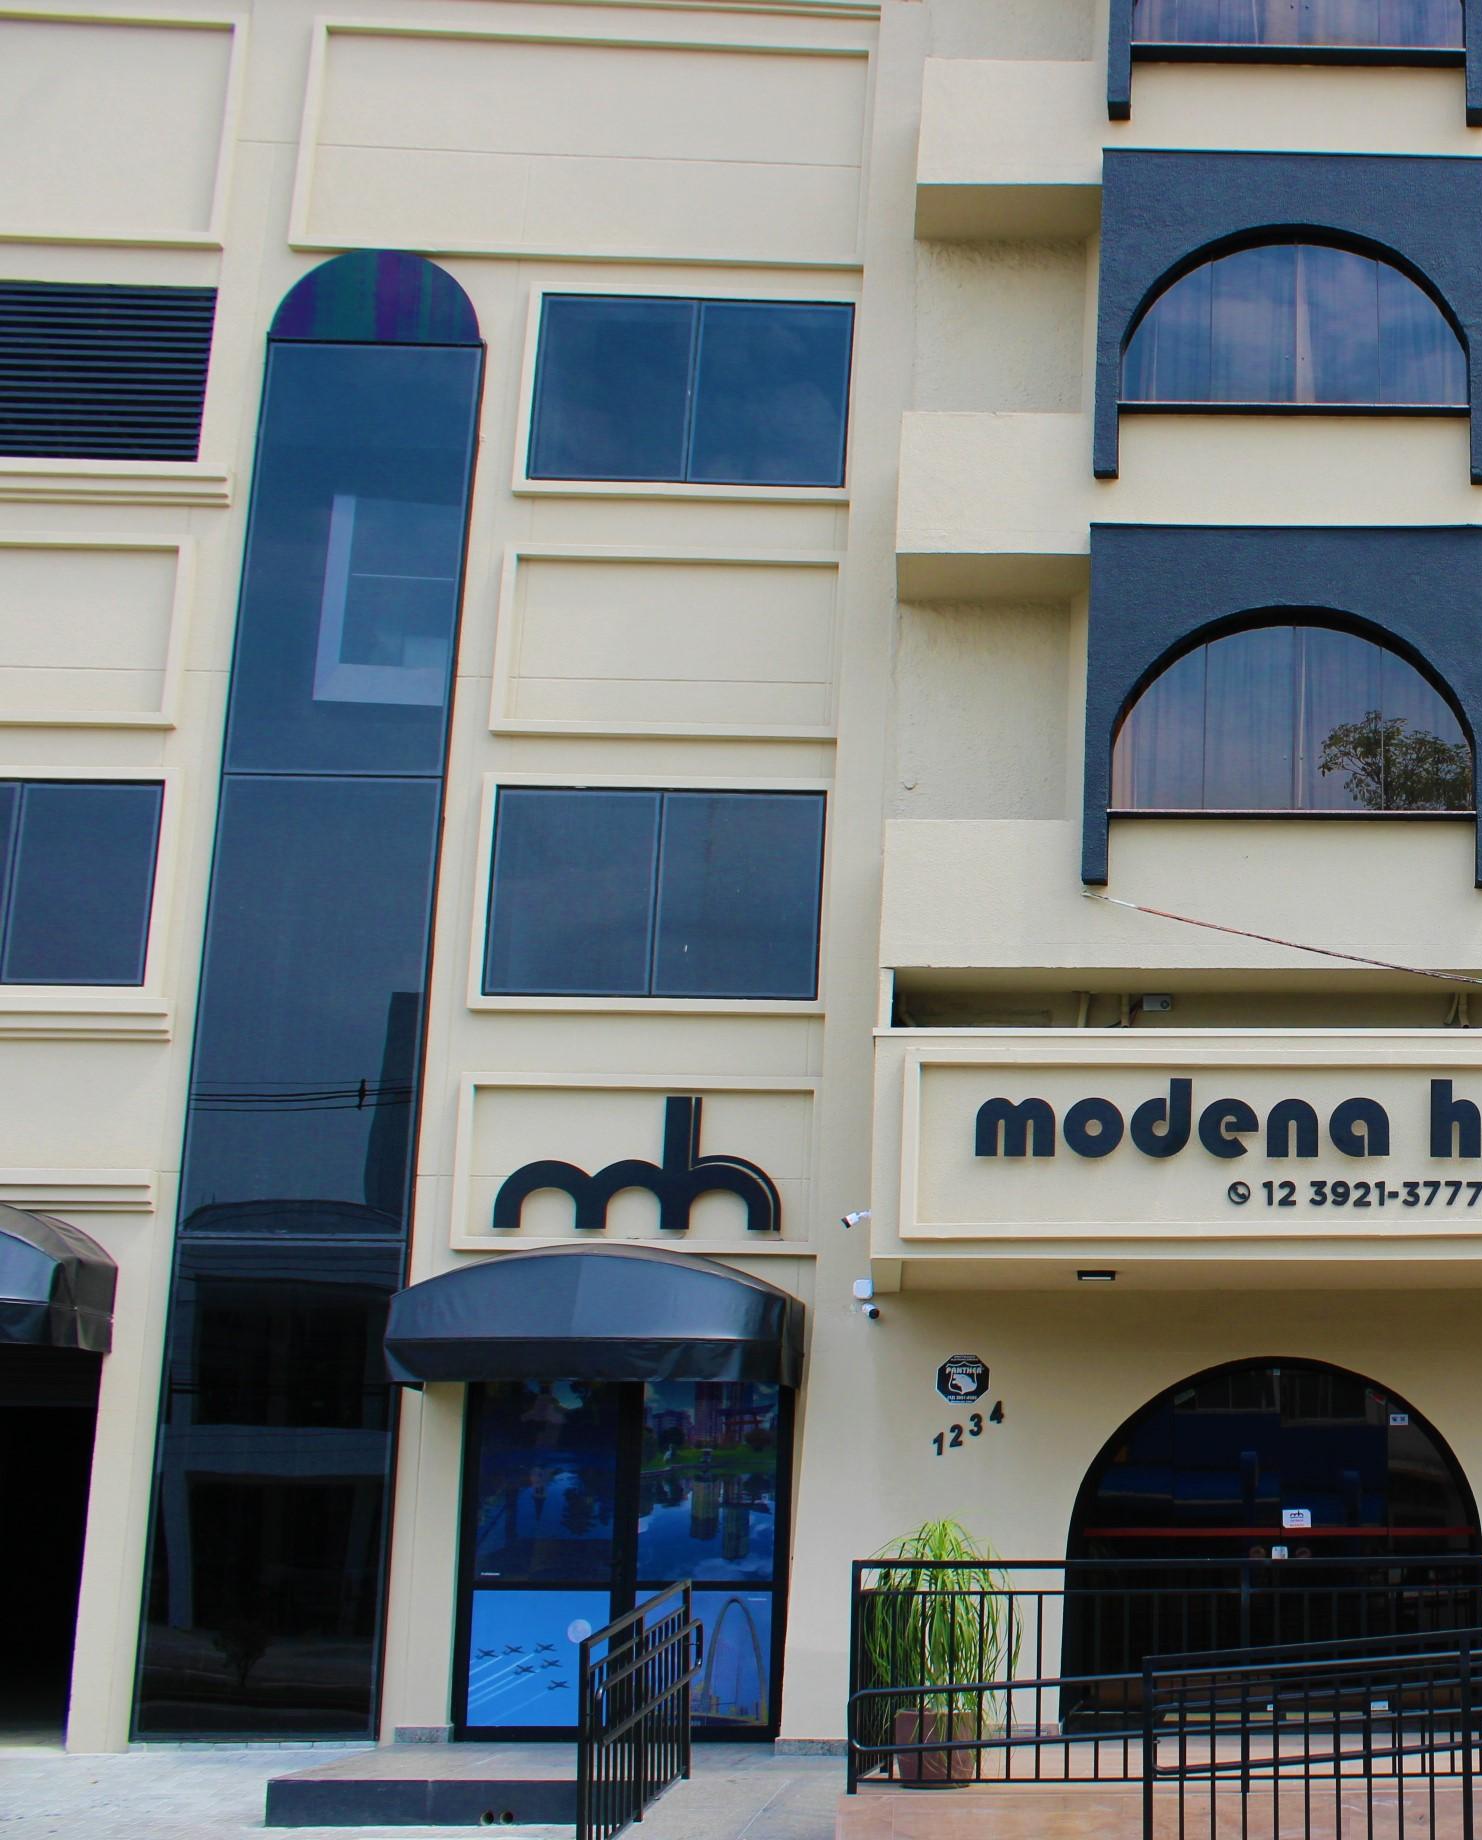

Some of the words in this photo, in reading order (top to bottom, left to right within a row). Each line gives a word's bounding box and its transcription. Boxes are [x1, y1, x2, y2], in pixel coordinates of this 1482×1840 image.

[974, 1077, 1390, 1159] modena
[1262, 1180, 1297, 1207] 12
[932, 1399, 1005, 1456] 1234
